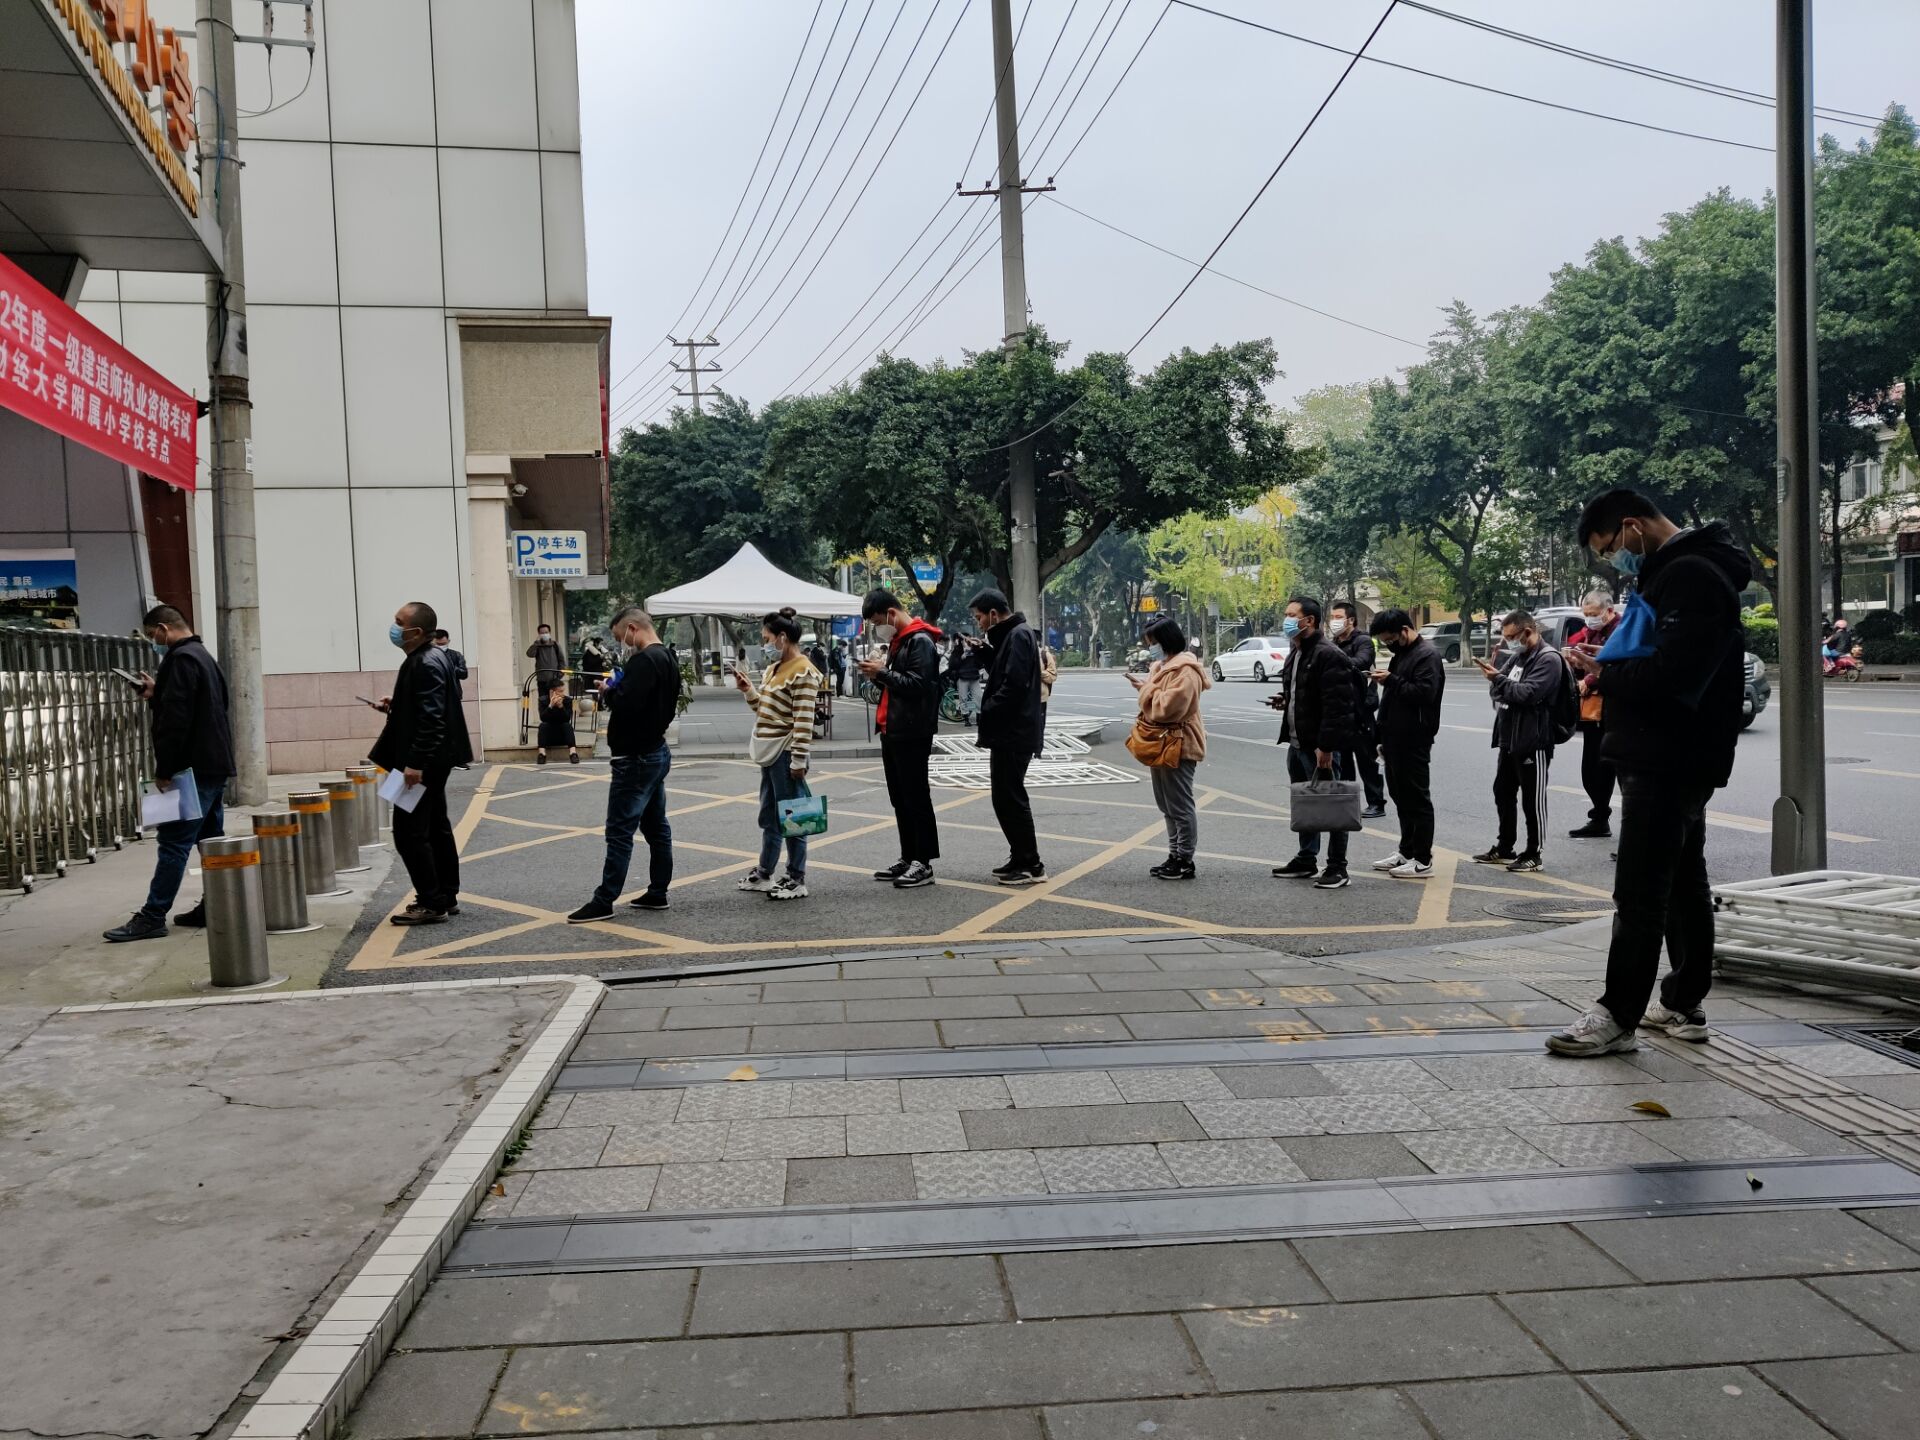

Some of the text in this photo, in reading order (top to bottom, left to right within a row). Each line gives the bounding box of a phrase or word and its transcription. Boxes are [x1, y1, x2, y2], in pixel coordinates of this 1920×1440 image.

[516, 535, 536, 567] P
[537, 536, 577, 549] 停车场
